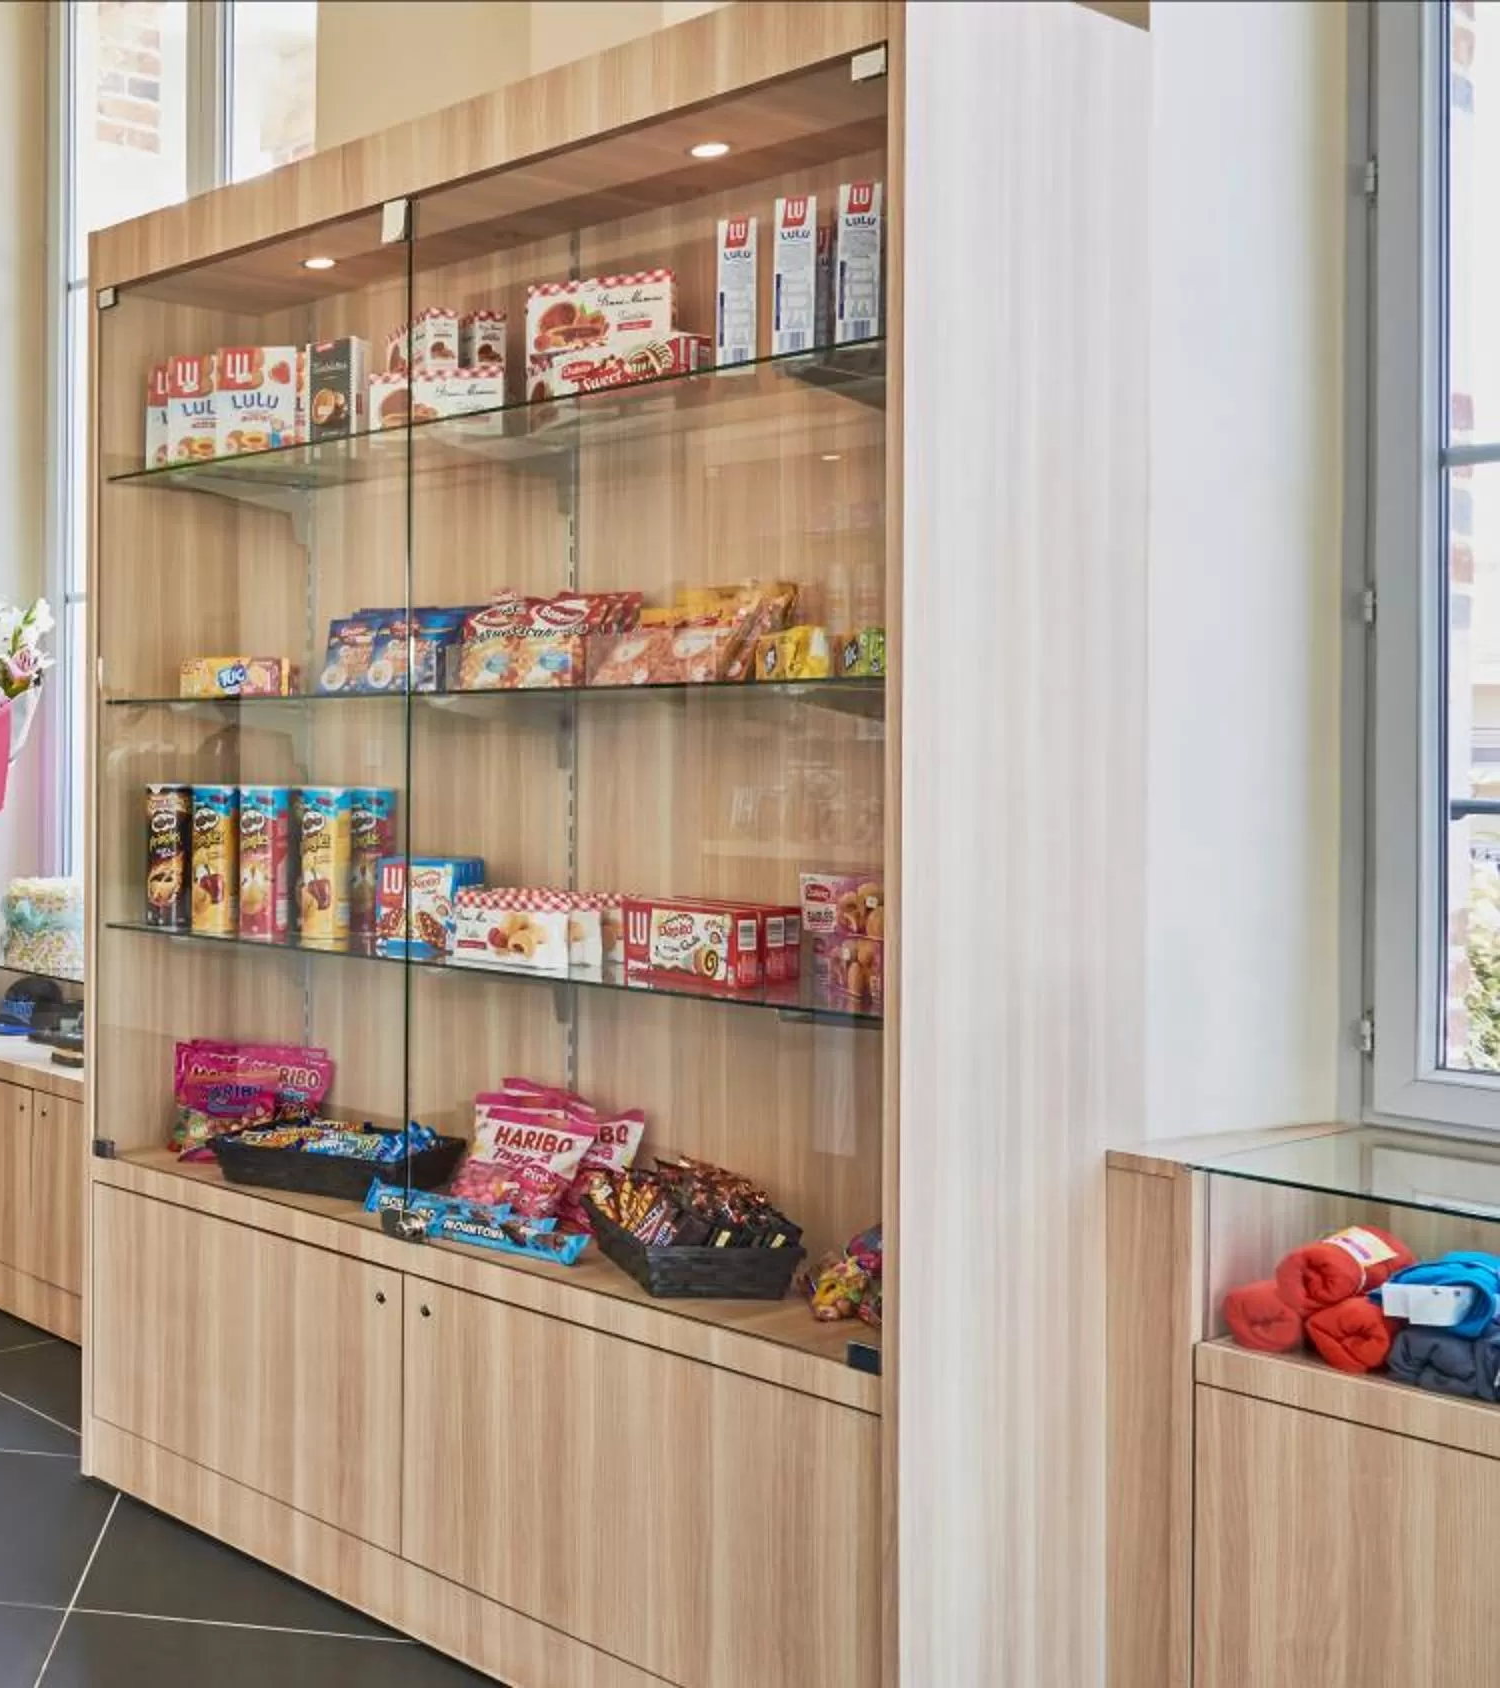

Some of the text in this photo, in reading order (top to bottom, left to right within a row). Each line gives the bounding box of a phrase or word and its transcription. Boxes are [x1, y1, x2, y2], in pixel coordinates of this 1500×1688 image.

[852, 187, 870, 205] LU
[786, 200, 804, 219] LU
[845, 215, 877, 228] LULU
[729, 222, 746, 241] LU
[780, 229, 811, 241] LULU
[723, 250, 751, 261] LULU
[177, 361, 199, 391] LU
[225, 352, 253, 384] LU
[181, 399, 217, 417] LUL
[230, 391, 280, 410] LULU
[218, 665, 246, 687] TUC
[383, 866, 403, 894] LU
[628, 911, 648, 945] LU
[277, 1066, 321, 1090] RIBO
[494, 1124, 573, 1154] HARIBO
